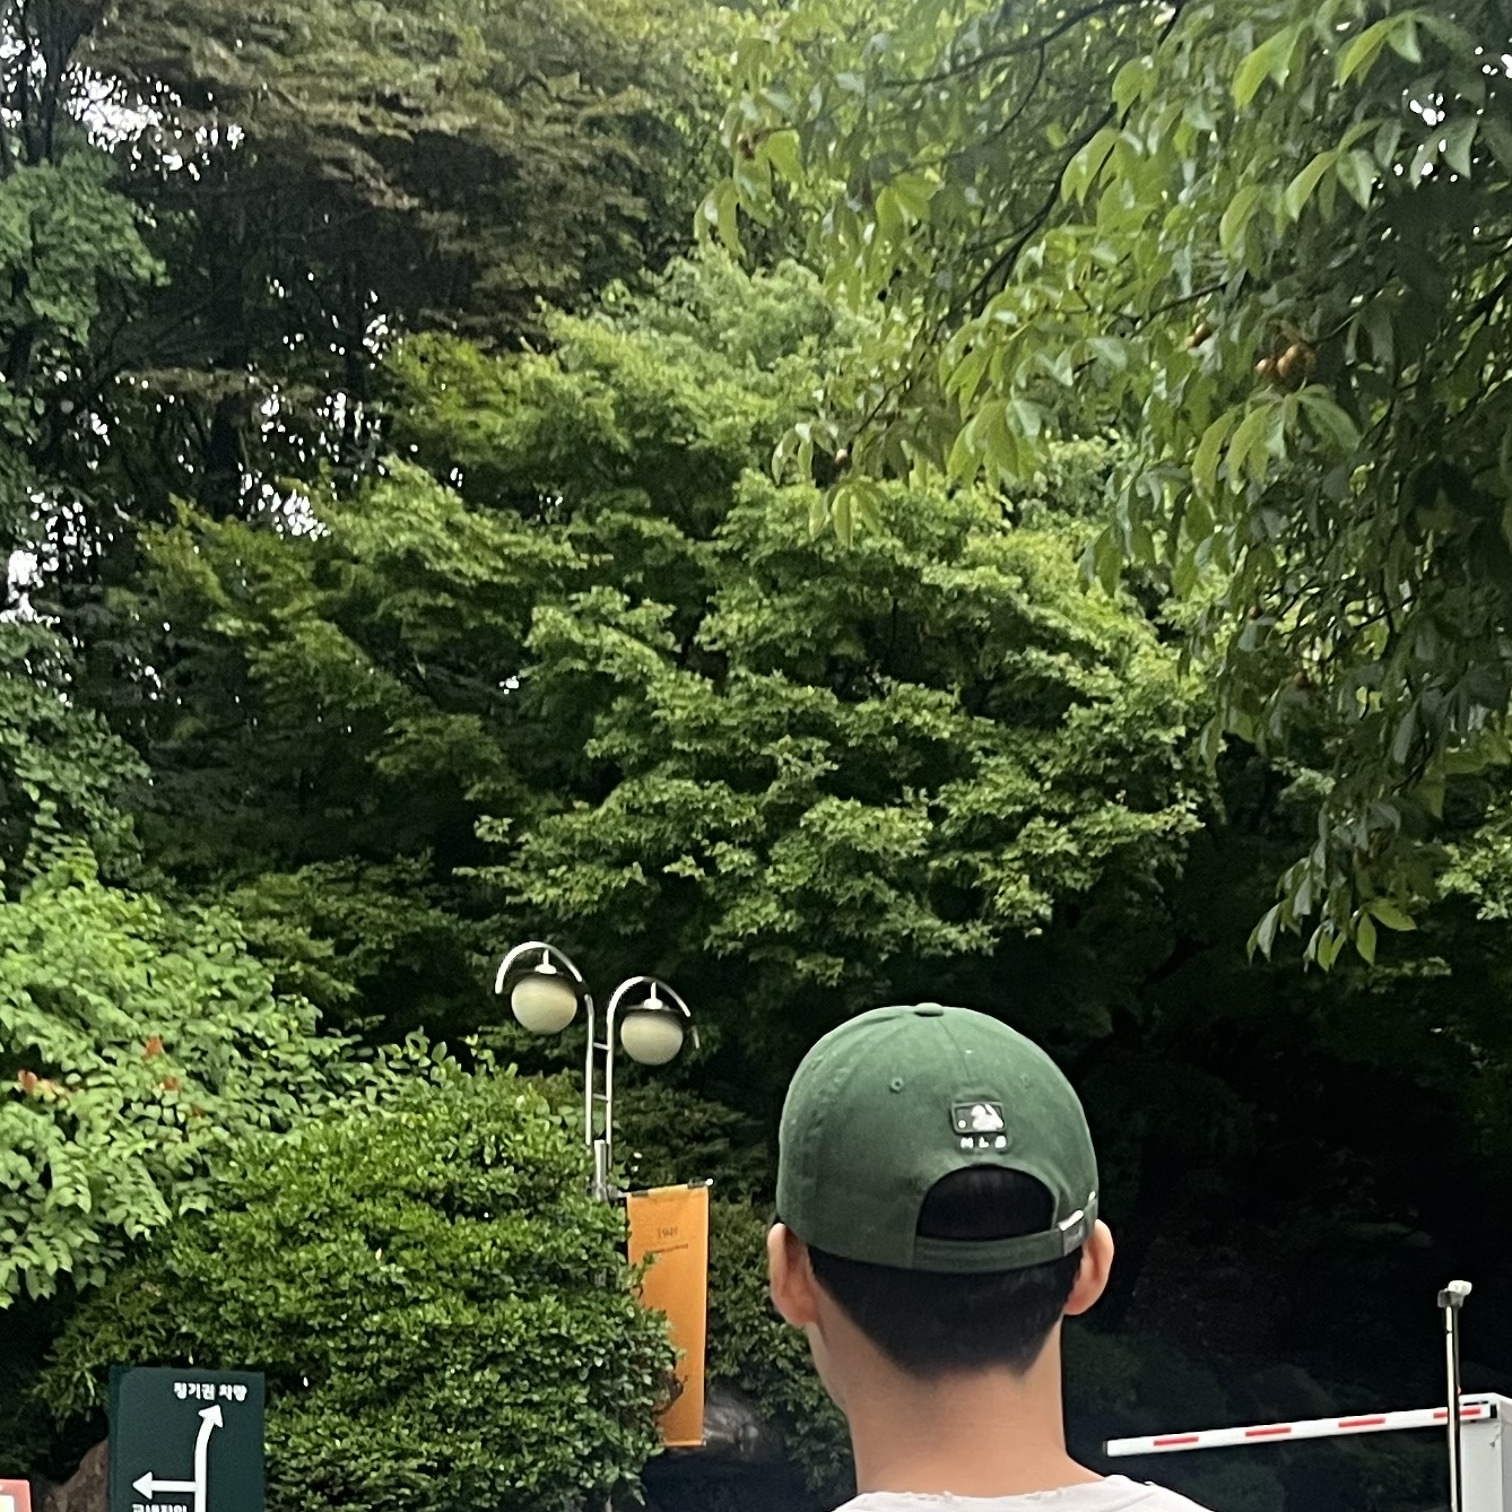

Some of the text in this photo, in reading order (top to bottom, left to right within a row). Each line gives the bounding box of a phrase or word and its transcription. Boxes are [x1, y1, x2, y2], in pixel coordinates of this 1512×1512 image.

[960, 1135, 1007, 1149] MLB
[173, 1381, 248, 1402] 정기권 차량
